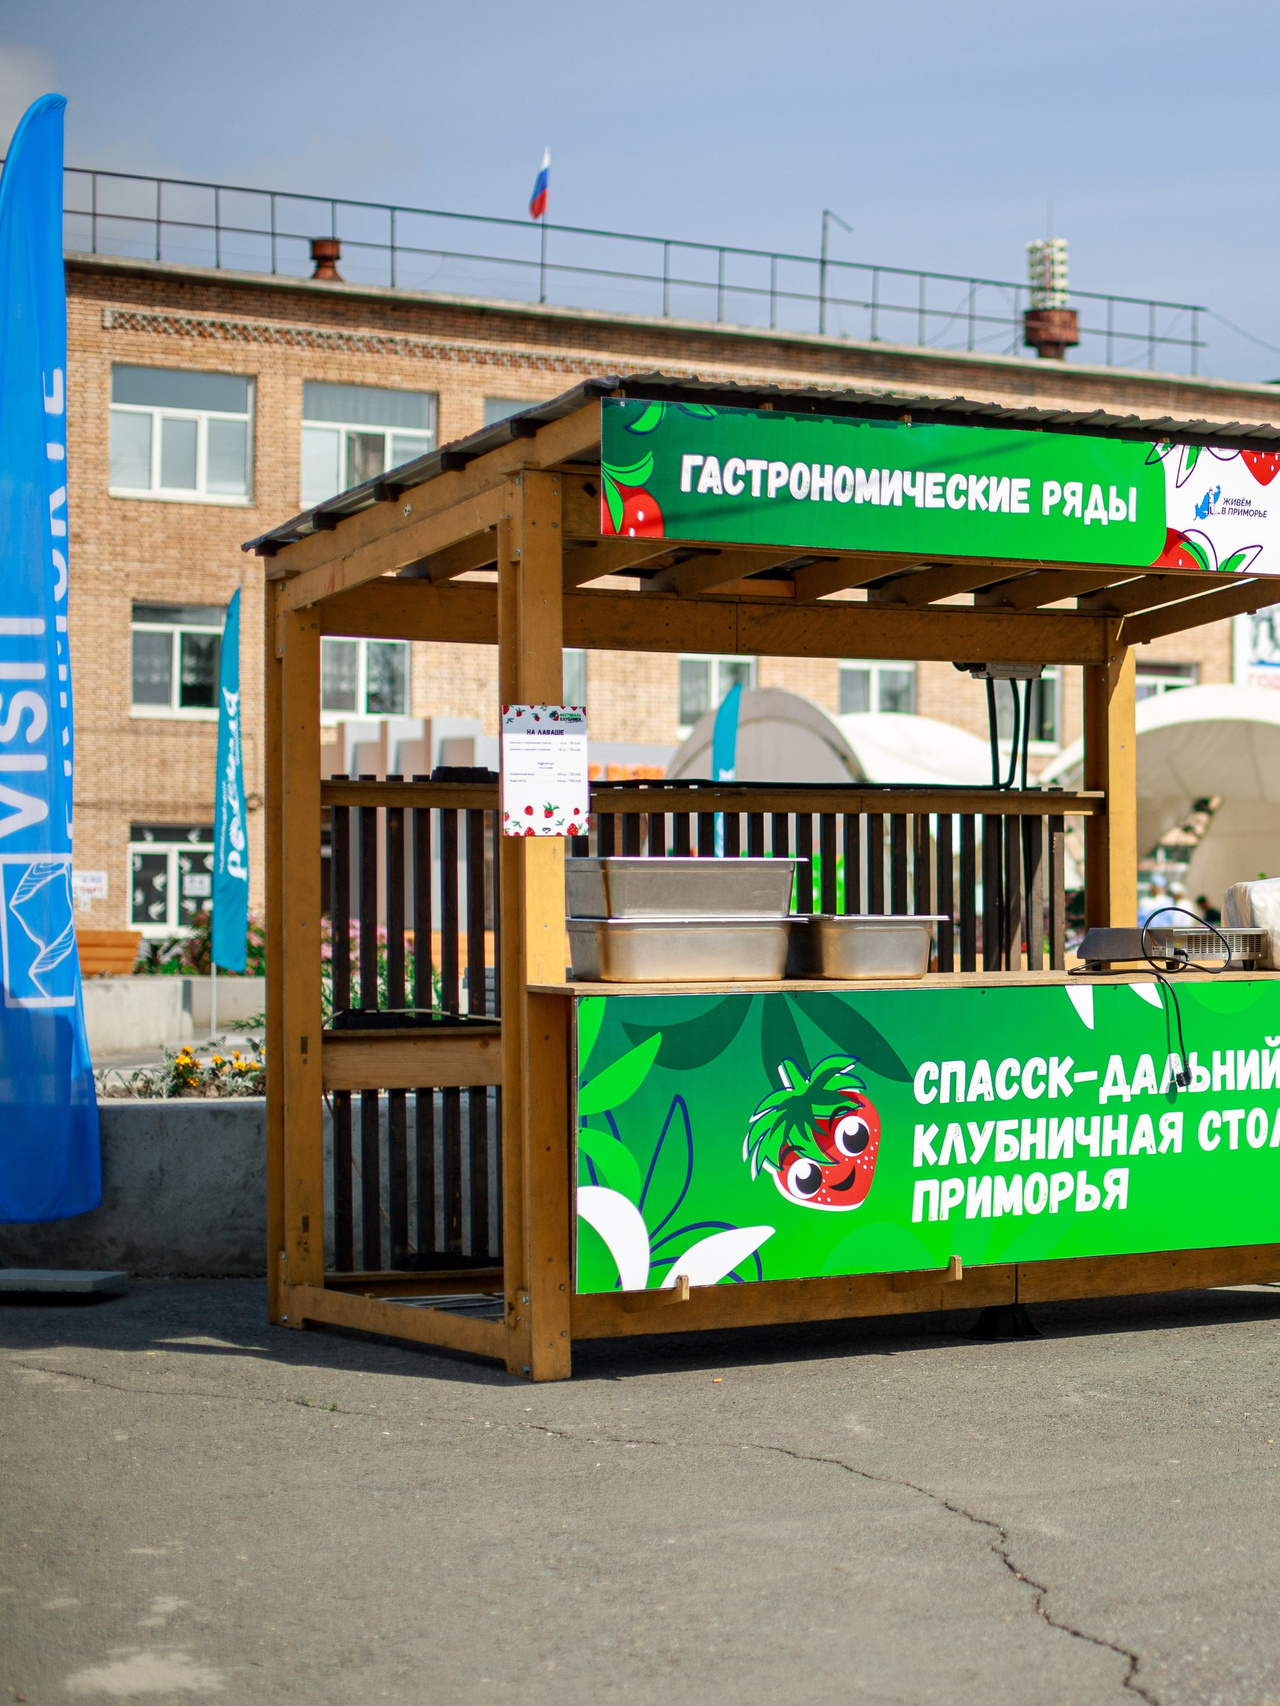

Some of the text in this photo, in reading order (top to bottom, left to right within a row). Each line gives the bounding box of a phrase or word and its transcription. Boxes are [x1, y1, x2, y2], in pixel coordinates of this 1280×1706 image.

[679, 453, 1138, 525] ГАСТРОНОМИЧЕСКИЕ РЯДЫ
[1221, 507, 1268, 518] В ПРИМОРЬЕ
[1223, 497, 1252, 508] ЖИВЁМ
[912, 1110, 1186, 1168] КЛУБНИЧНАЯ
[911, 1167, 1129, 1223] ПРИМОРЬЯ
